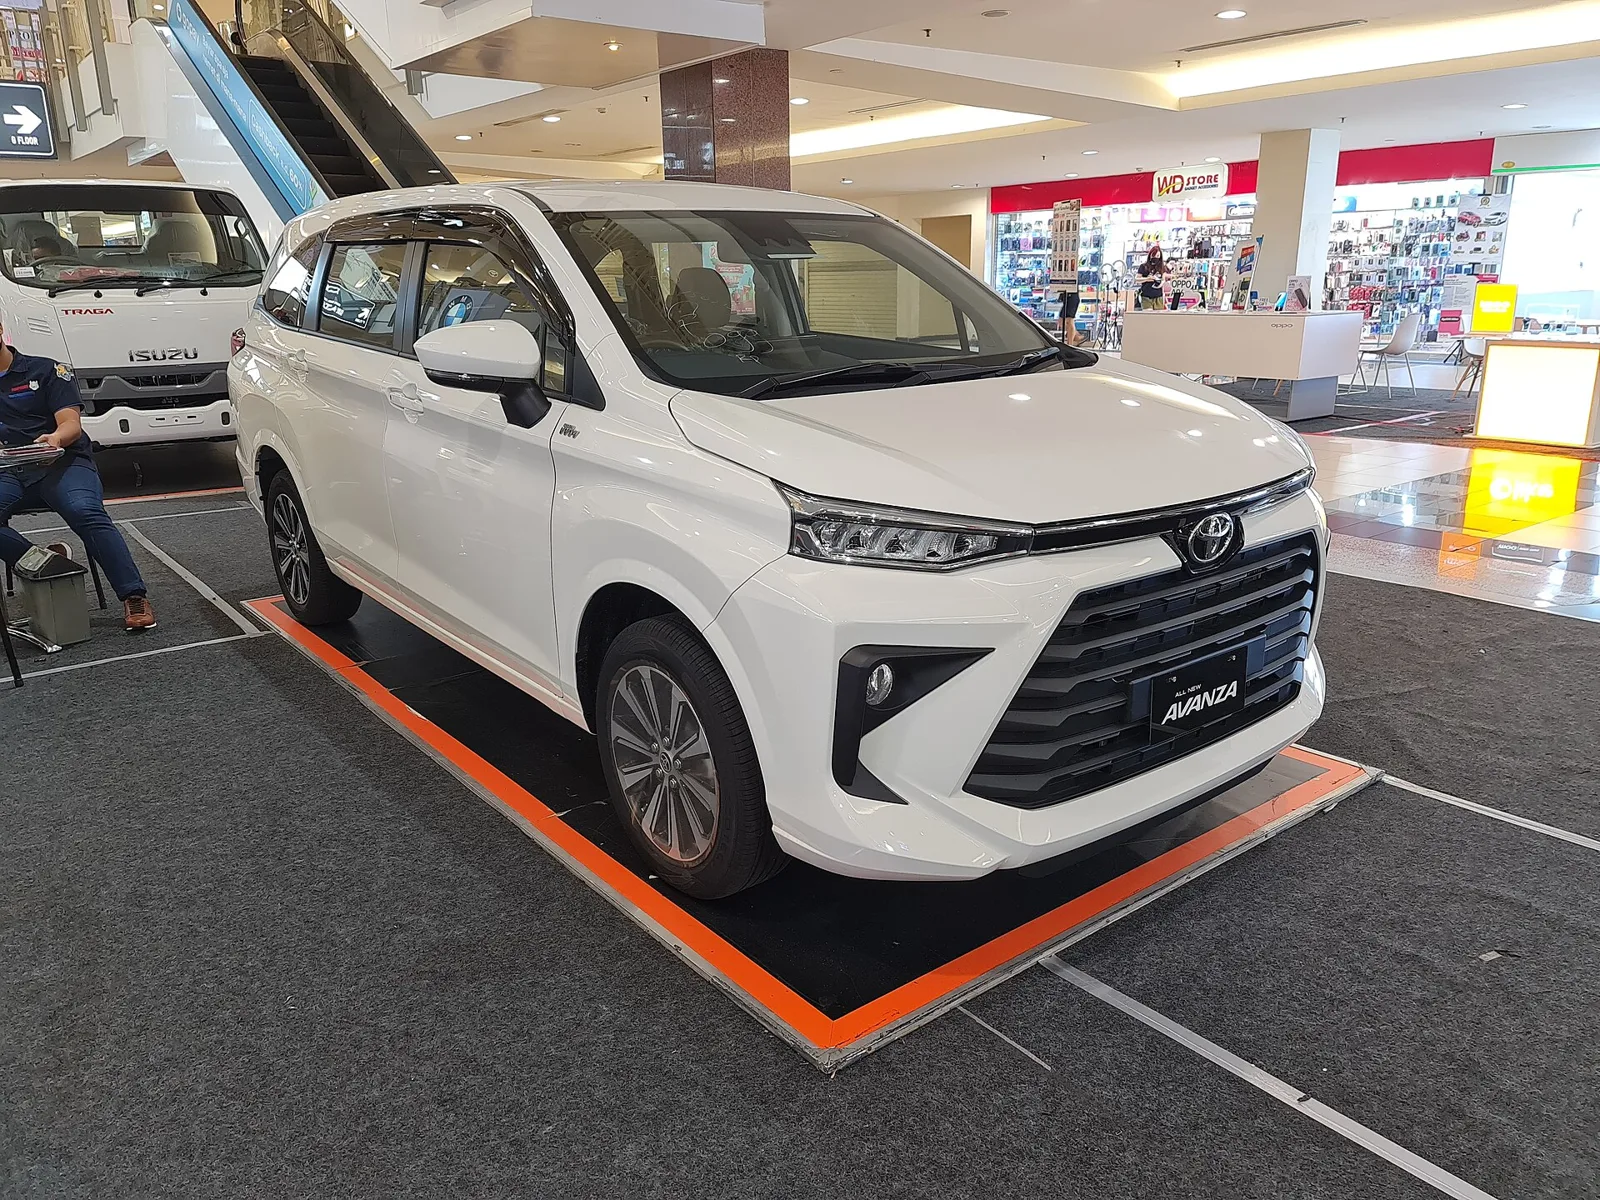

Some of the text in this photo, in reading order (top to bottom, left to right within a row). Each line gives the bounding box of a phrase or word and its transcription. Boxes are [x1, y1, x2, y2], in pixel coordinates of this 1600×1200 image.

[17, 136, 39, 146] FLOOR
[251, 114, 280, 158] Cashback
[1157, 174, 1219, 197] WD STORE
[1171, 280, 1192, 289] OPPO
[61, 308, 114, 316] TRAGA
[128, 347, 198, 362] ISUZU
[1175, 684, 1202, 698] ALL NEW
[1161, 680, 1238, 725] AVANZA
